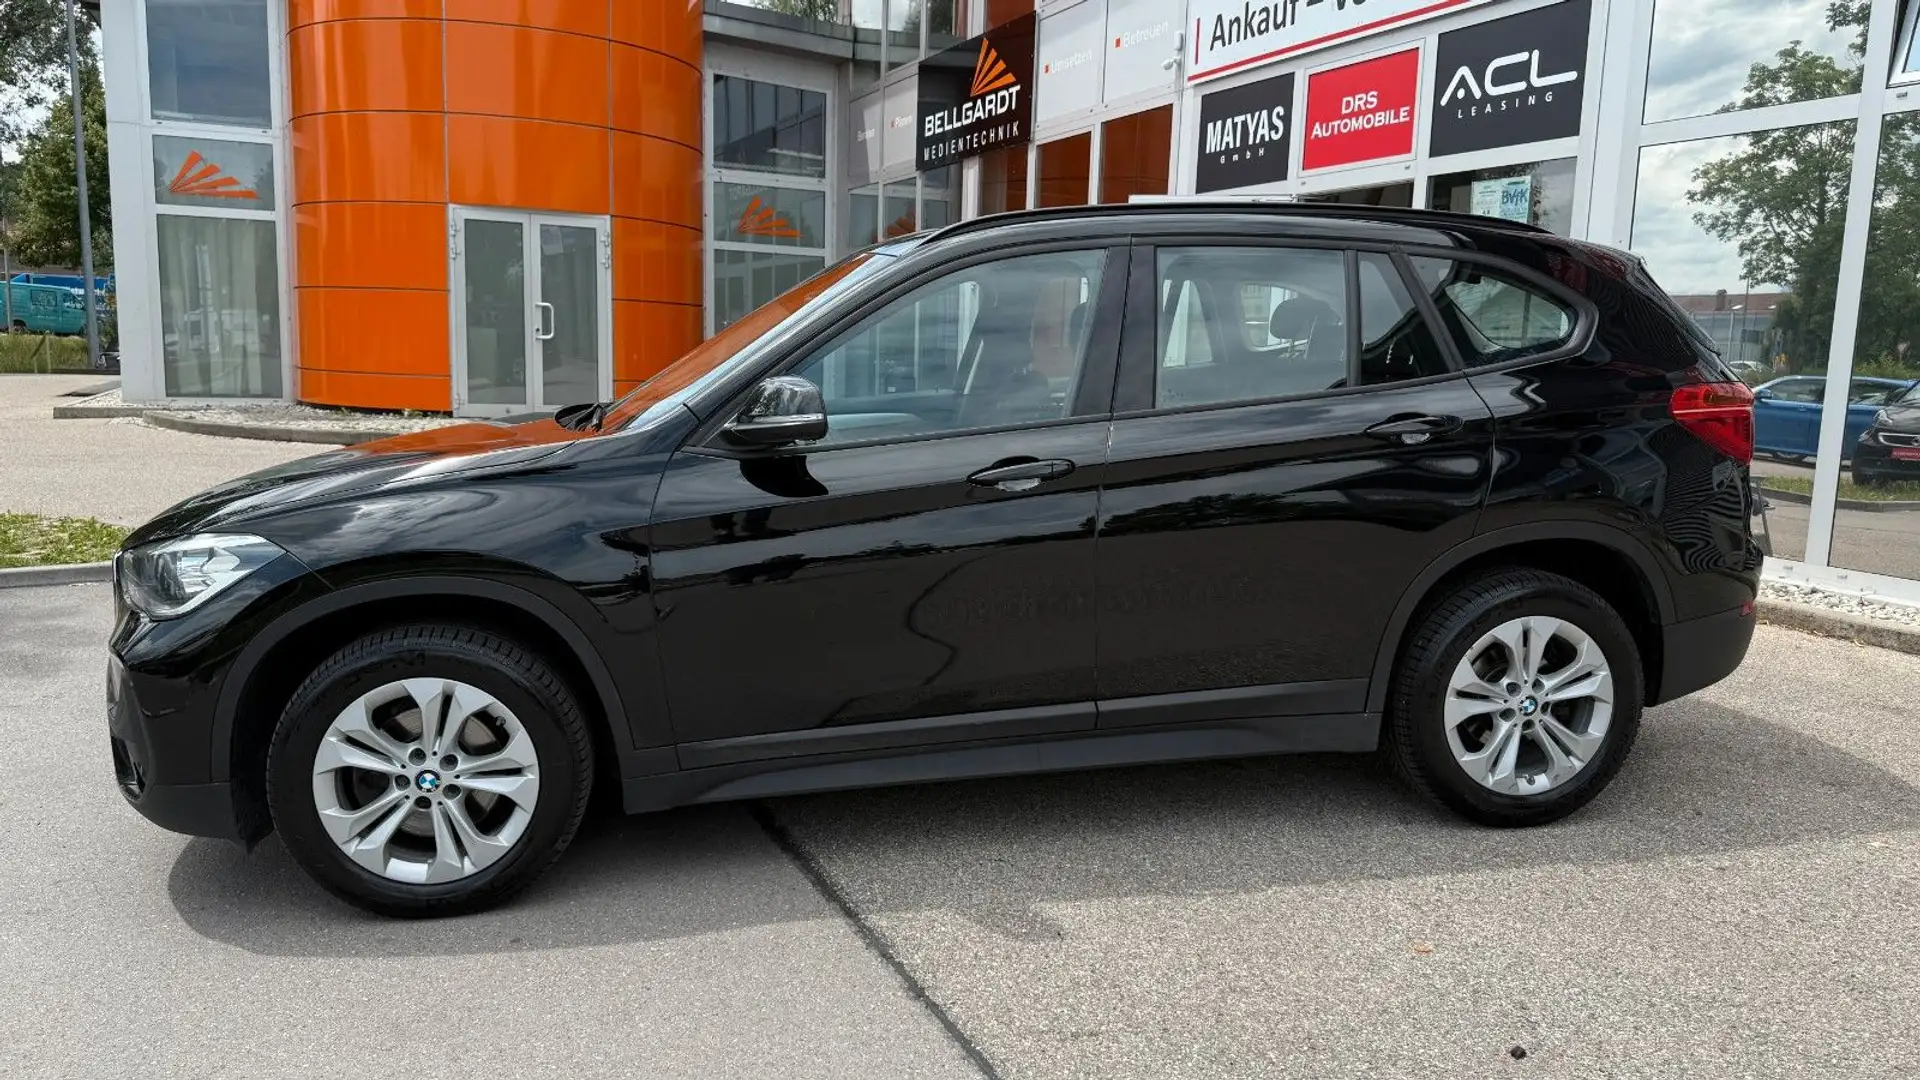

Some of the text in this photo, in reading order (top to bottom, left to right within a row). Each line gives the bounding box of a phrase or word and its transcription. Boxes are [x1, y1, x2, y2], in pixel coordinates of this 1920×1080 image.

[1210, 0, 1299, 51] Ankauf
[1440, 49, 1578, 106] ACL
[925, 84, 1021, 137] BELLGARDT
[1310, 106, 1410, 140] AUTOMOBILE
[1341, 90, 1378, 115] DRS
[1457, 91, 1553, 119] LEASING
[924, 120, 1019, 161] MEDIENTECHNIK
[1206, 105, 1284, 154] MATYAS
